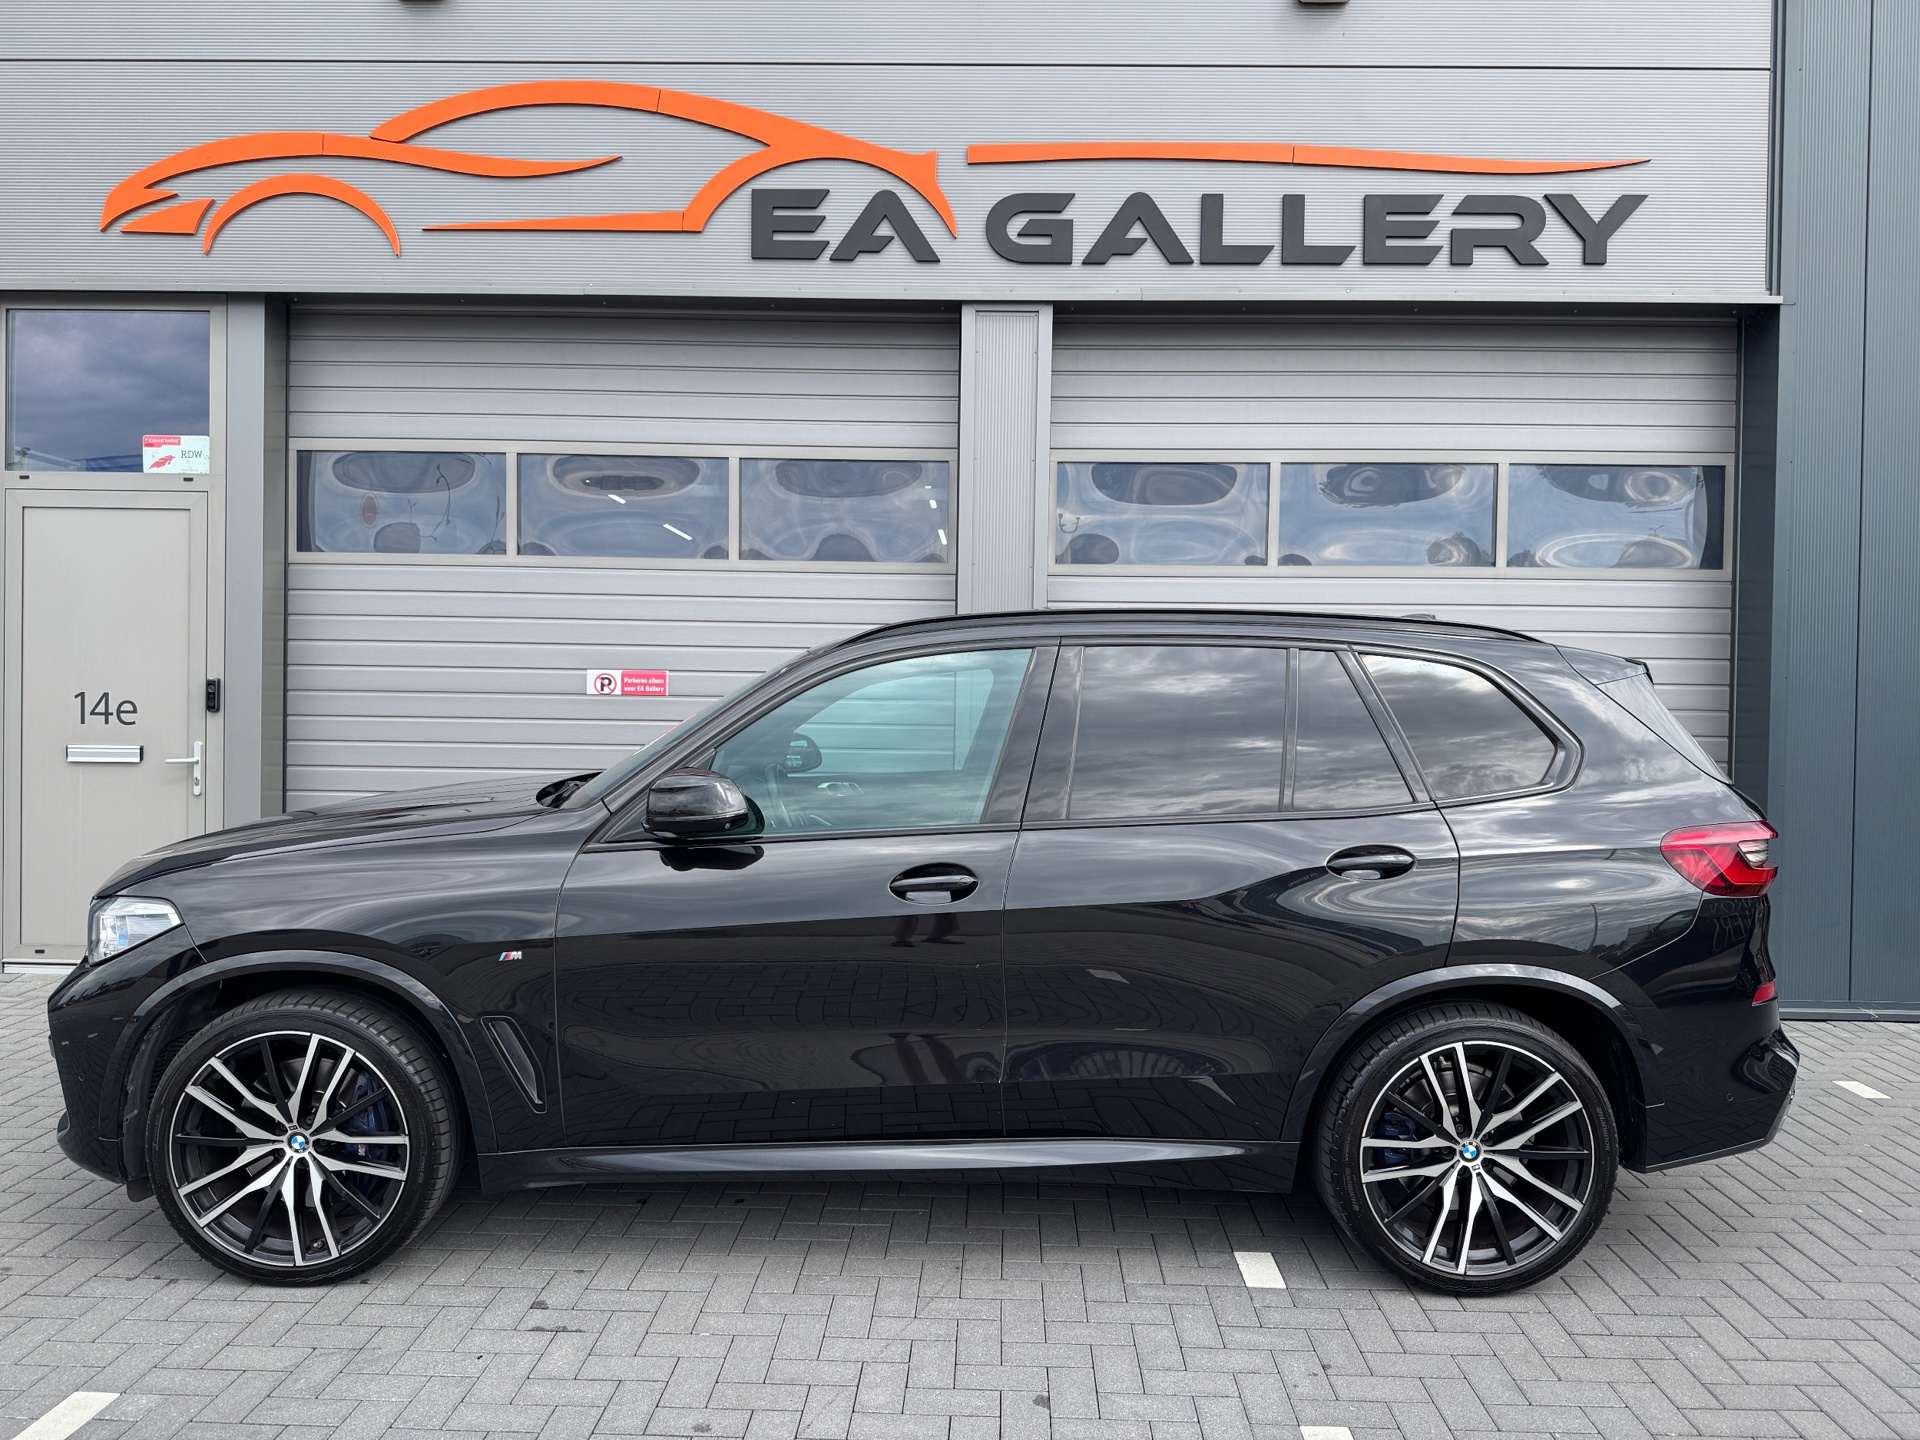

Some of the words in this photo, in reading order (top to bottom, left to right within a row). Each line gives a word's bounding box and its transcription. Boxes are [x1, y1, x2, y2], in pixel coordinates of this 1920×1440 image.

[750, 188, 941, 263] EA
[984, 191, 1650, 267] GALLERY
[180, 450, 203, 459] RDW
[73, 691, 138, 726] 14e
